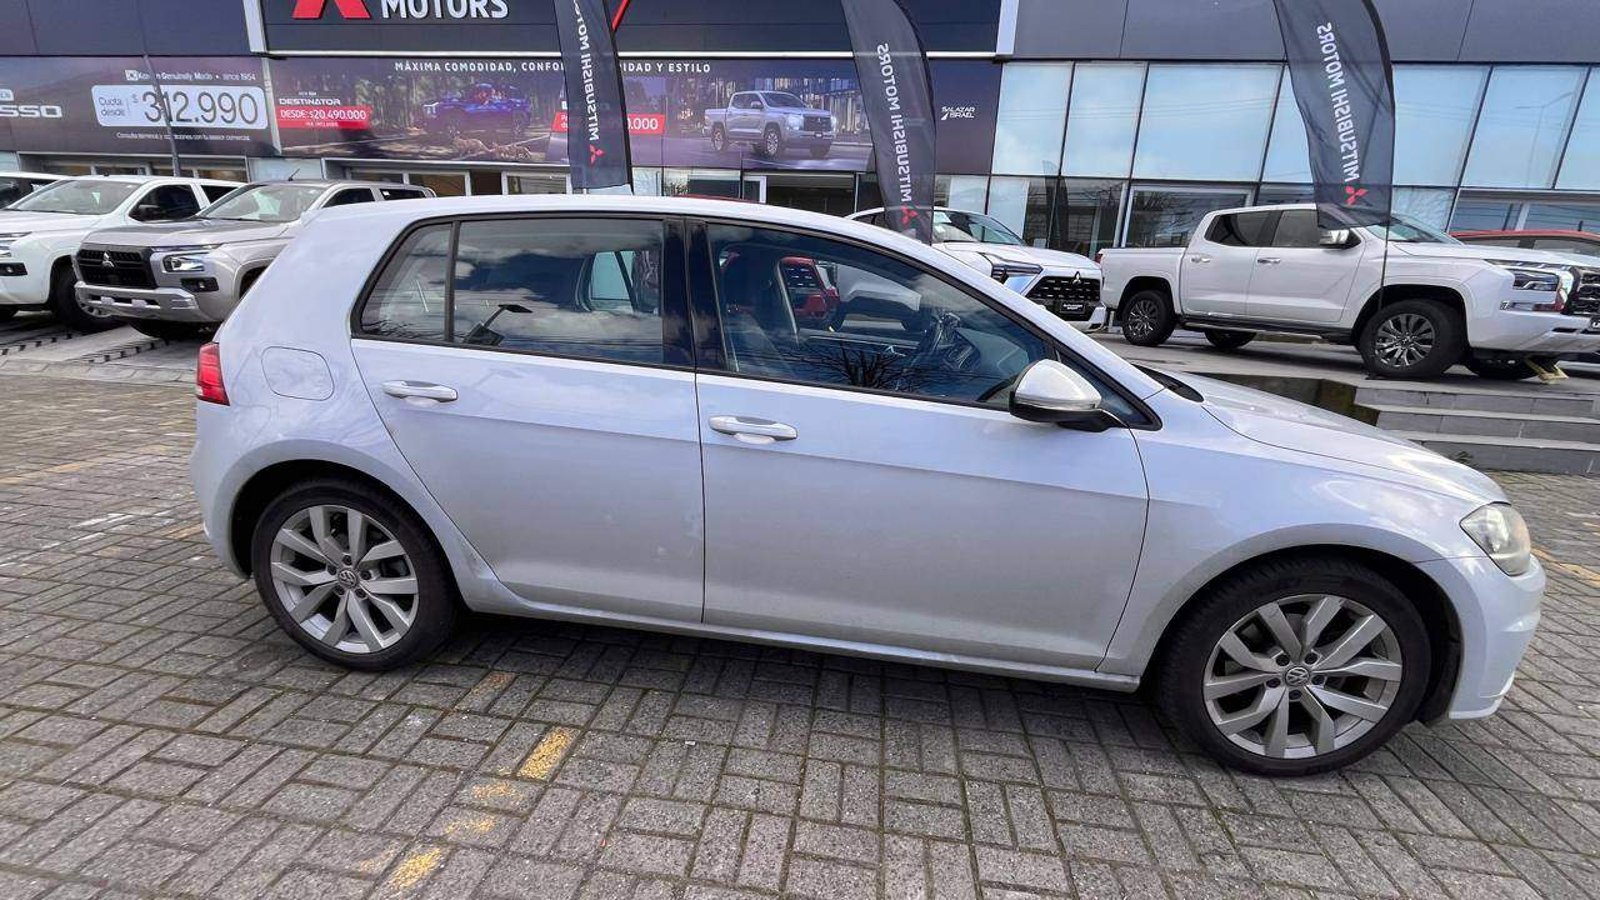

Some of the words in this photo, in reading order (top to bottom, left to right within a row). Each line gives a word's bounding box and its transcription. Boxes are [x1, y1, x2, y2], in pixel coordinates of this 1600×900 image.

[381, 0, 509, 19] MOTORS
[444, 62, 517, 73] COMODIDAD,
[656, 63, 663, 72] Y
[668, 63, 711, 73] ESTILO
[98, 97, 122, 106] Cuota
[142, 91, 258, 125] 312.990
[279, 98, 341, 106] DESTINATOR
